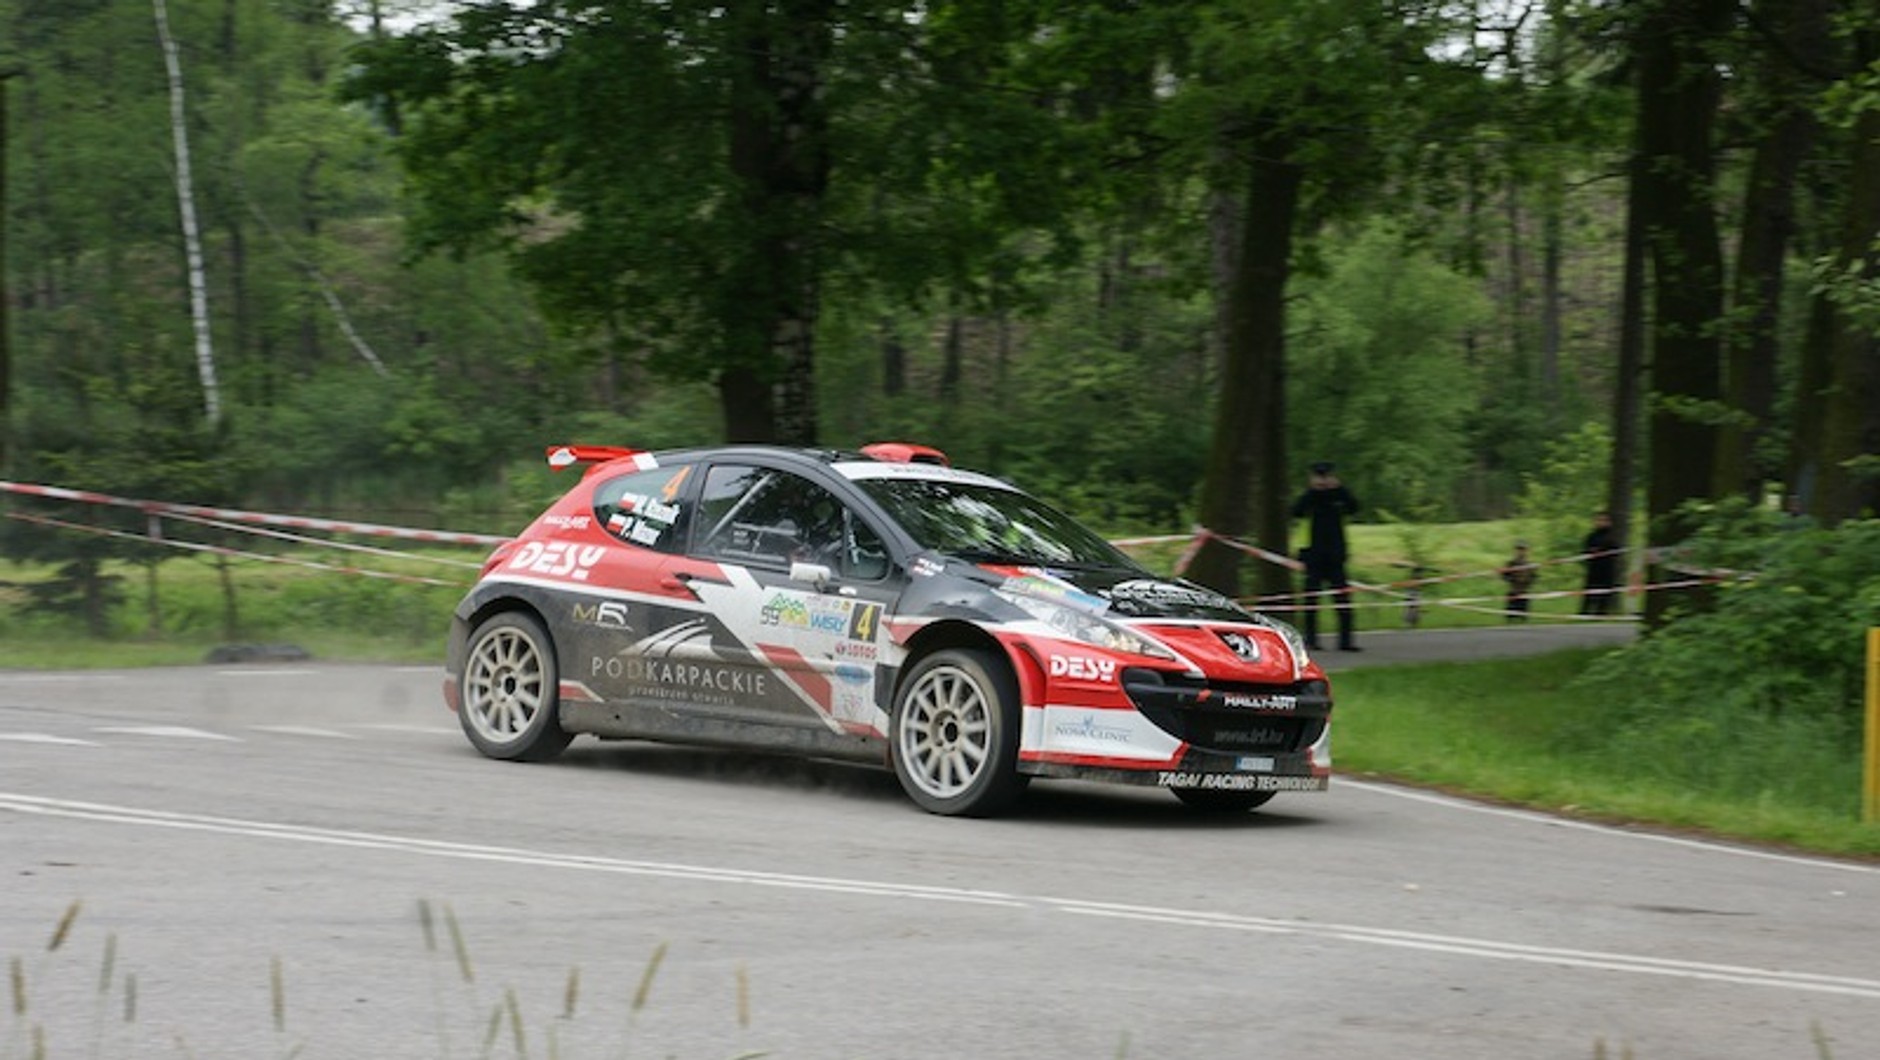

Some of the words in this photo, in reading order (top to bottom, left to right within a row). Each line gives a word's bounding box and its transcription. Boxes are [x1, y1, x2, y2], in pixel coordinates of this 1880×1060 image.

[662, 464, 692, 502] 4
[508, 540, 607, 580] DESY
[855, 602, 876, 641] 4
[591, 656, 767, 696] PODKARPACKIE
[1050, 654, 1116, 682] DESY
[1201, 774, 1255, 790] RACING
